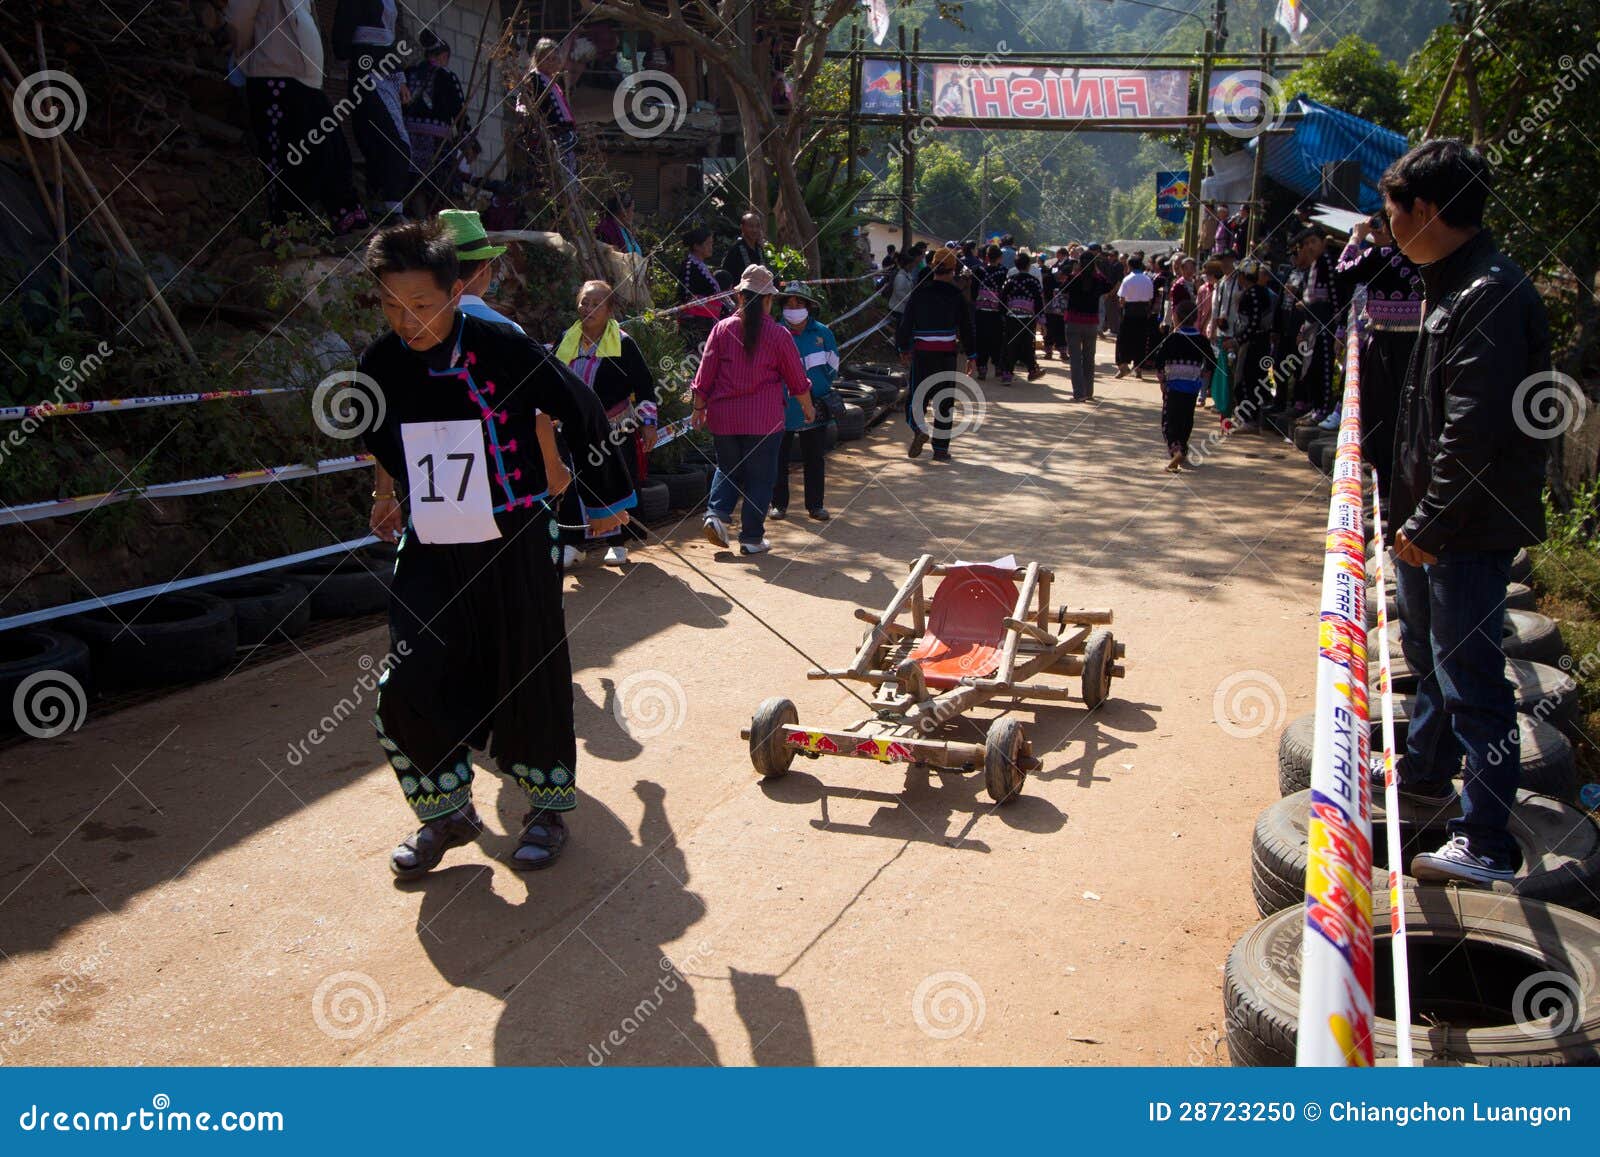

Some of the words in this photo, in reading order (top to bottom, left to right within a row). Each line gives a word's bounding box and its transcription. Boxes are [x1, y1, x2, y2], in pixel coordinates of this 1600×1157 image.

[418, 453, 475, 502] 17
[1336, 572, 1351, 620] EXTRA
[1334, 706, 1352, 800] EXTRA
